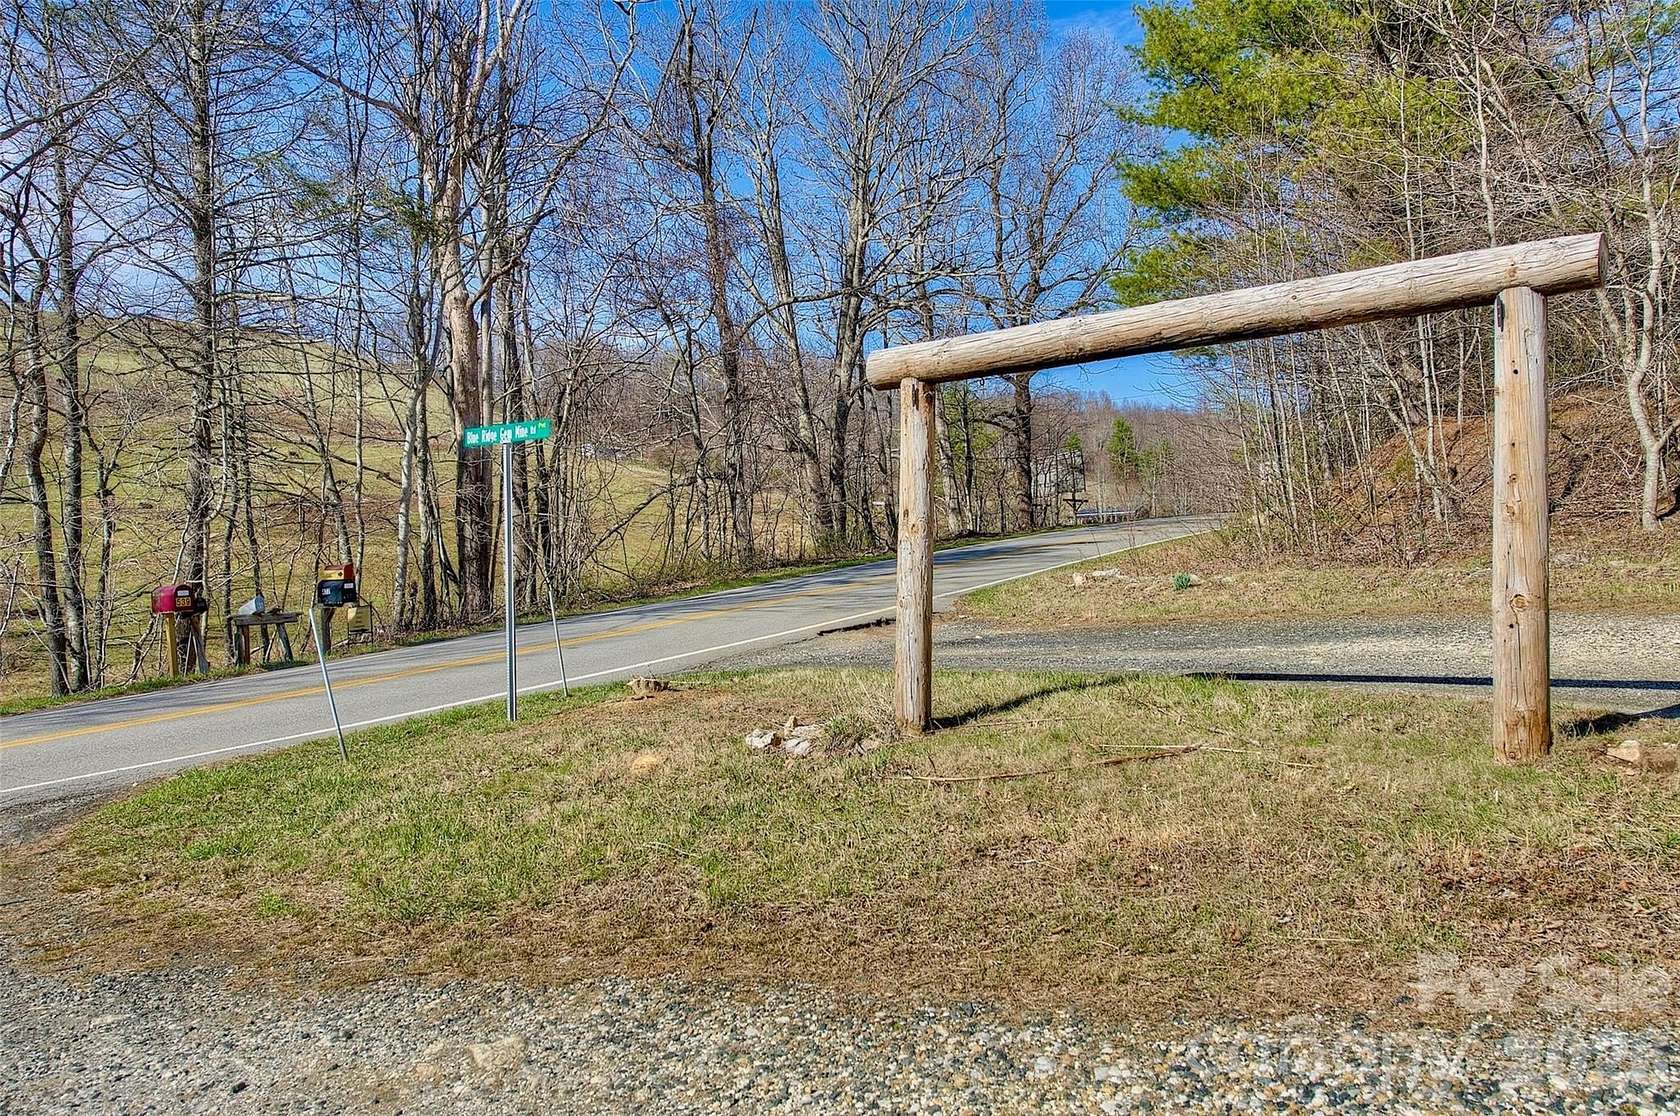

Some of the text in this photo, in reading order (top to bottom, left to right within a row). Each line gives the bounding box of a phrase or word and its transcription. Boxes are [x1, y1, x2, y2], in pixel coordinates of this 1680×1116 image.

[467, 431, 479, 444] Blue
[481, 429, 498, 443] Ridge
[515, 425, 528, 438] Mine
